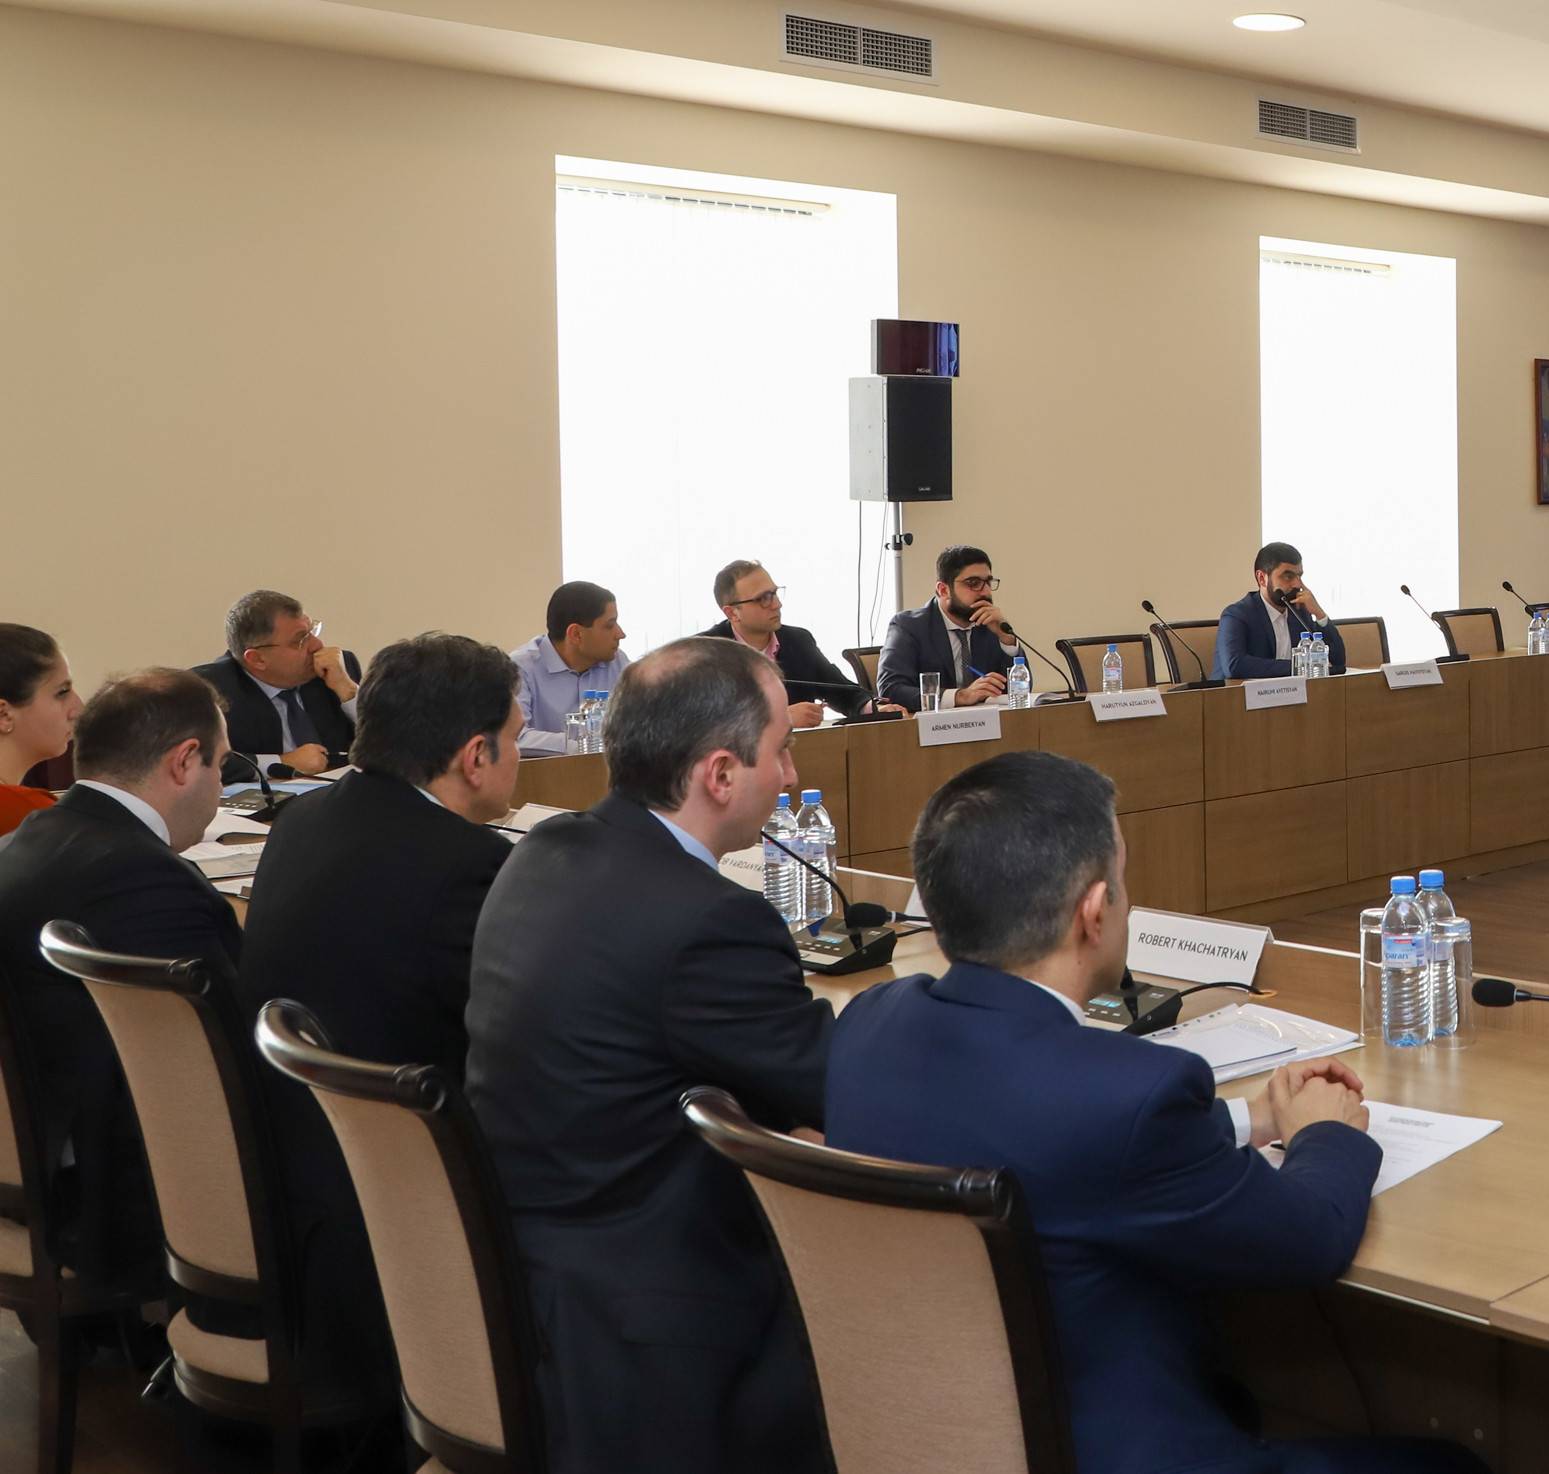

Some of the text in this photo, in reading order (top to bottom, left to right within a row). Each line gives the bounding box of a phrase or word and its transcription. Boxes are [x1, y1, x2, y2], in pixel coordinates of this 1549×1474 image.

[931, 724, 952, 732] ARMEN
[1138, 932, 1249, 962] ROBERT KHACHATRYAN
